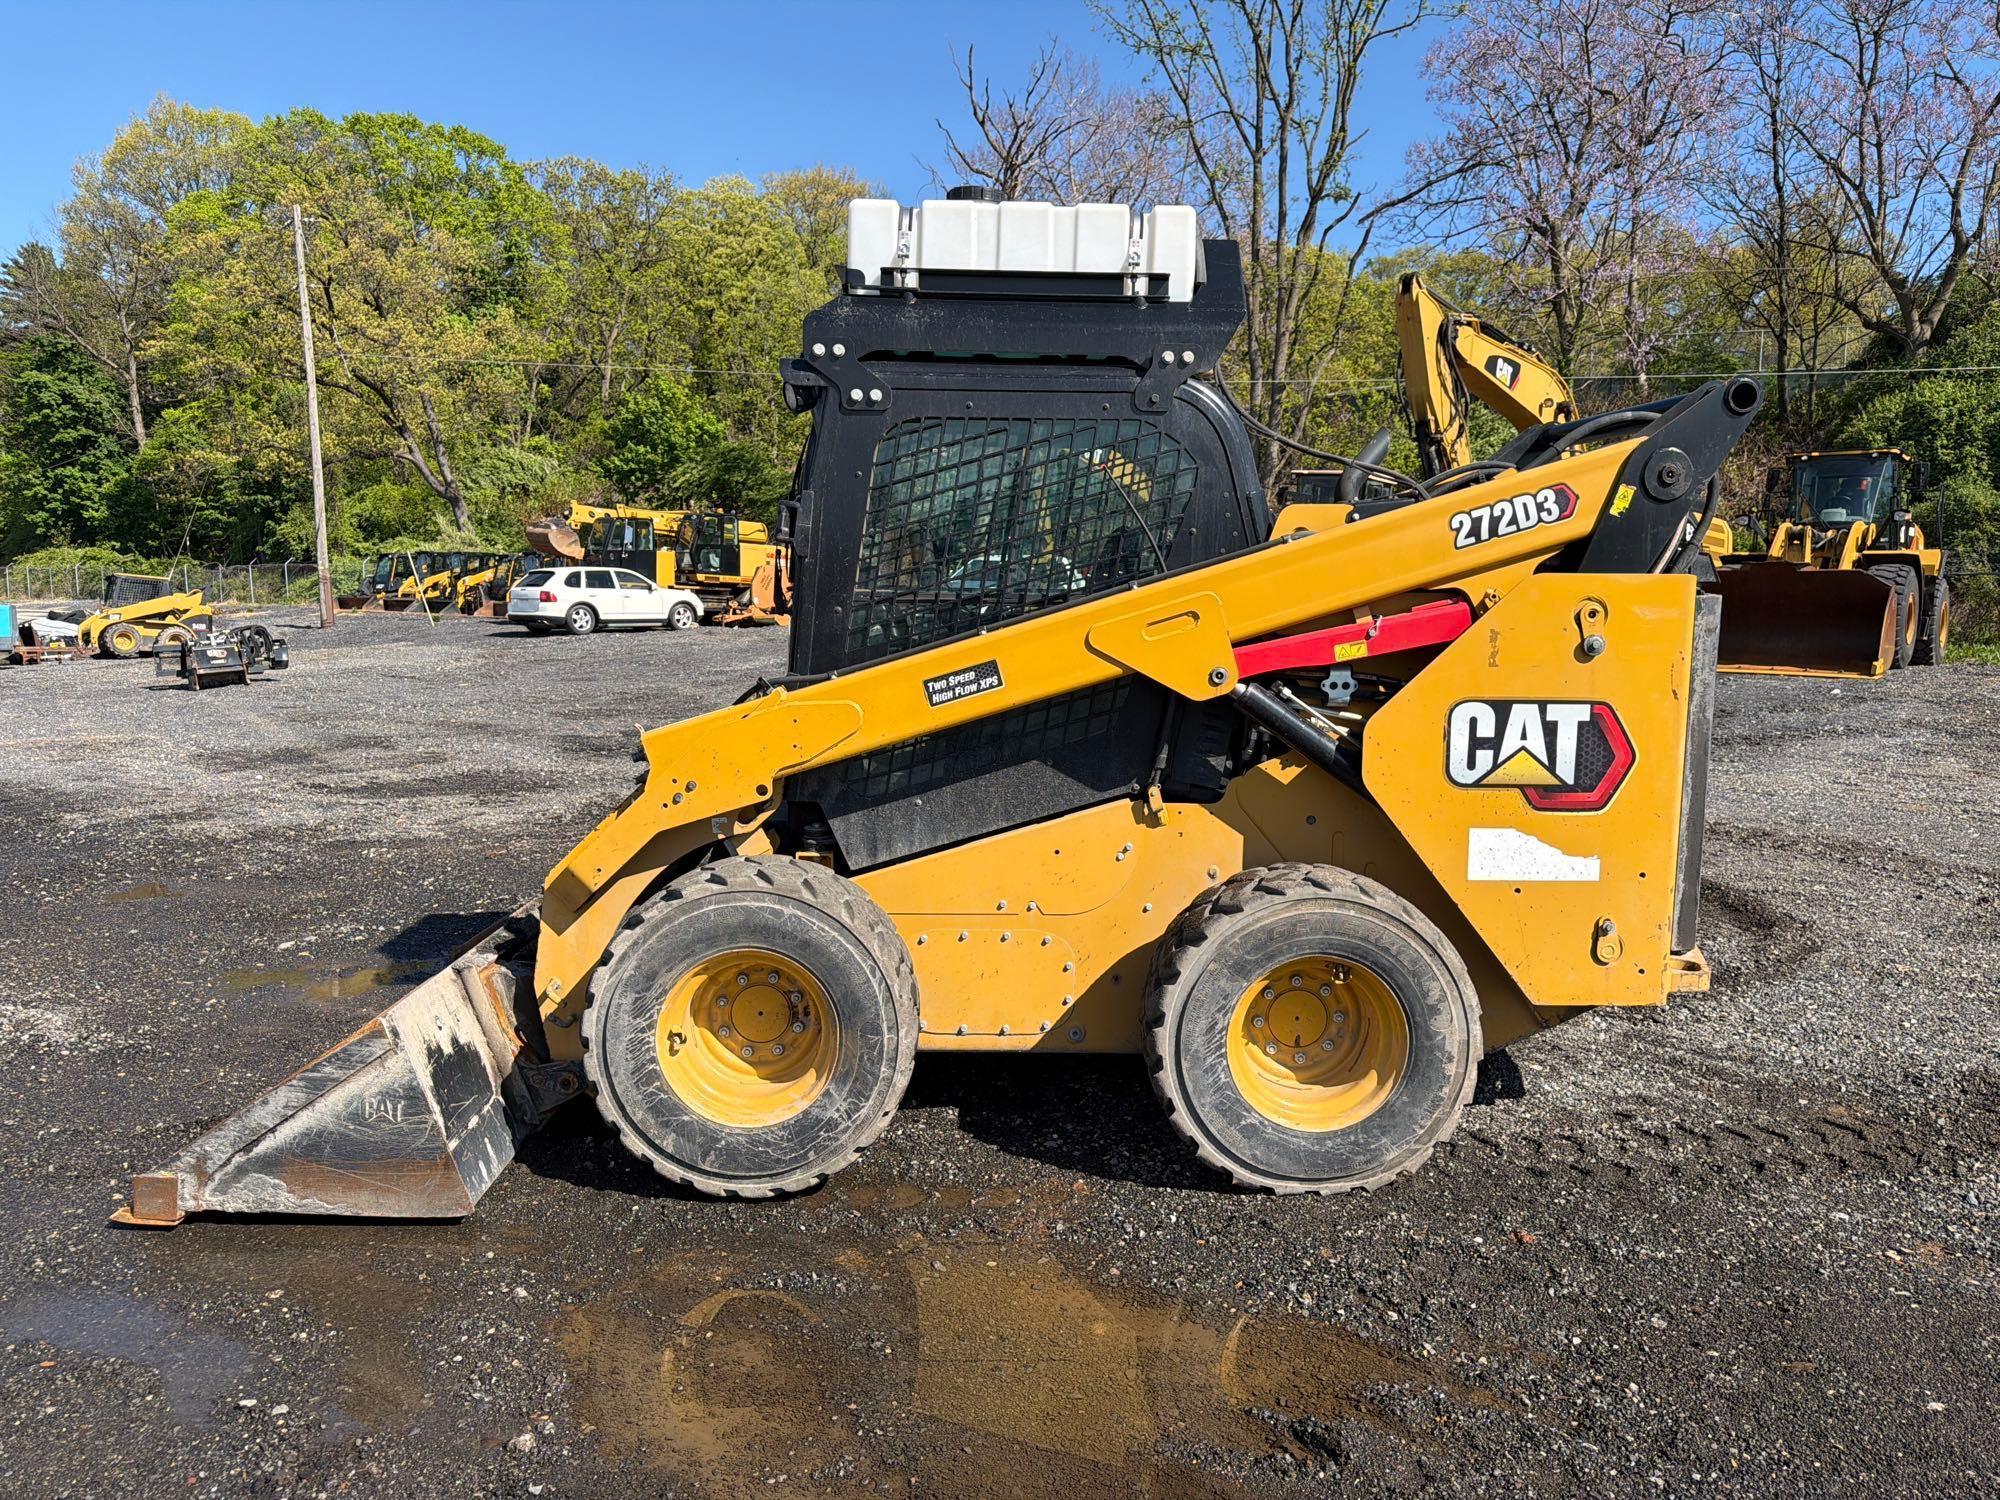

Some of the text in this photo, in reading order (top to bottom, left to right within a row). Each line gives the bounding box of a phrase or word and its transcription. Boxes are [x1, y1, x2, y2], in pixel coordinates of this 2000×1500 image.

[1495, 358, 1514, 387] CAT
[1450, 488, 1561, 549] 272D3
[927, 671, 976, 693] TWO SPEED
[932, 675, 999, 705] HIGH FLOW XPS
[1450, 701, 1592, 786] CAT
[360, 1095, 405, 1123] CAT
